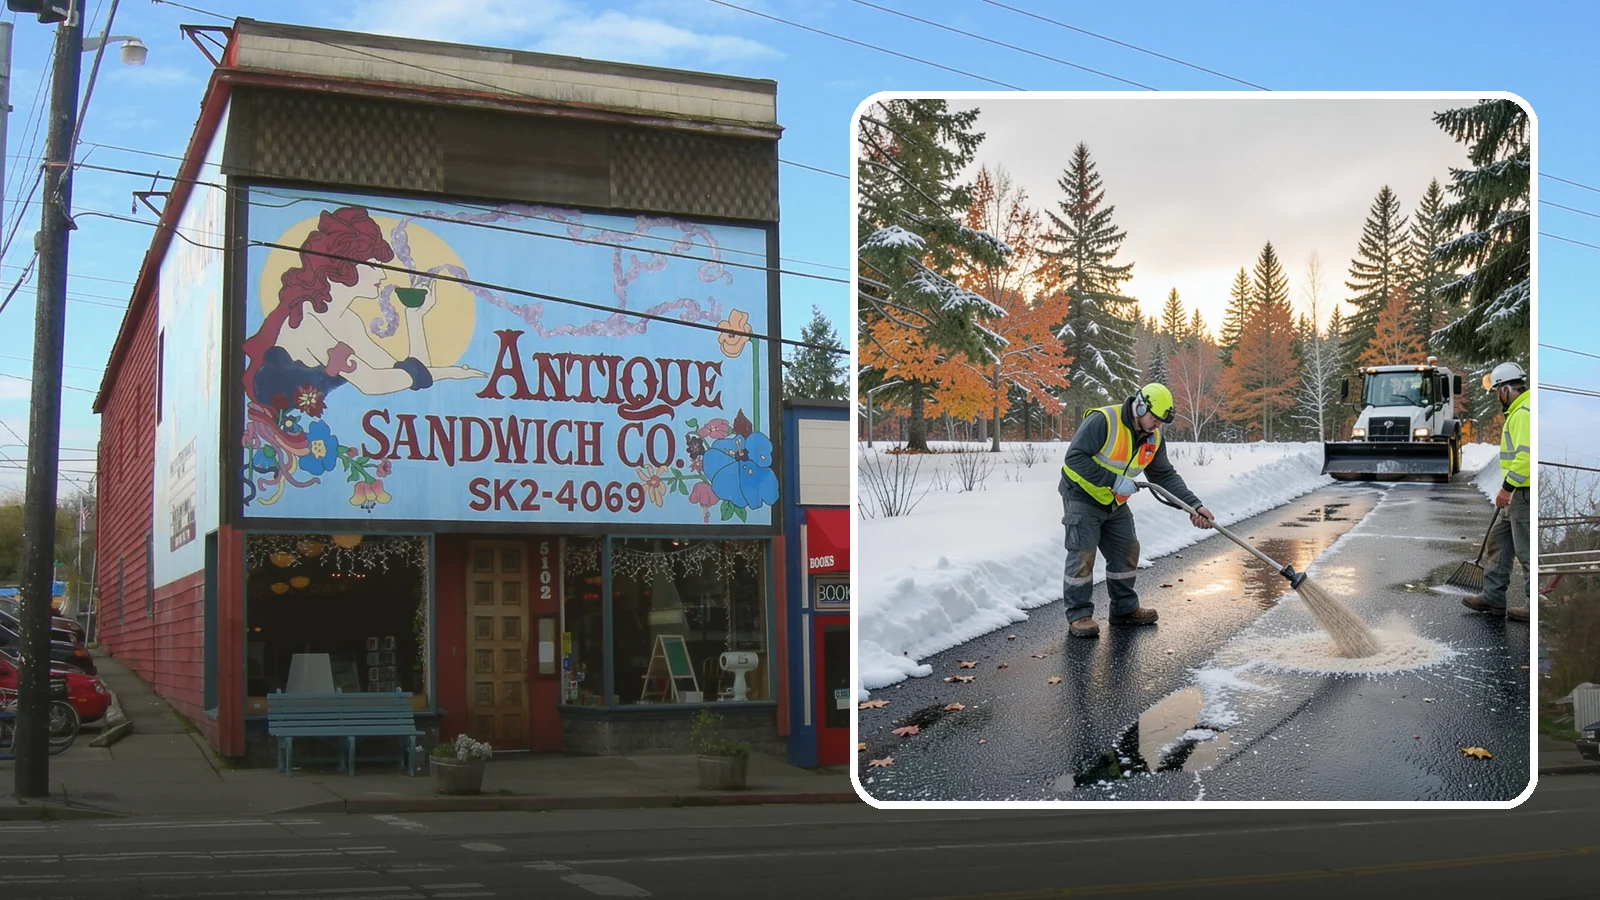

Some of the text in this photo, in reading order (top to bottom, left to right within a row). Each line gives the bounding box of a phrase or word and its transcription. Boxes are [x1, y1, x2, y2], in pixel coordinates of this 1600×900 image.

[475, 329, 724, 421] ANTIQUE
[361, 408, 685, 470] SANDWICH CO.
[468, 476, 645, 513] SK2-4069
[539, 541, 552, 600] 5102
[809, 555, 835, 569] BOOKS
